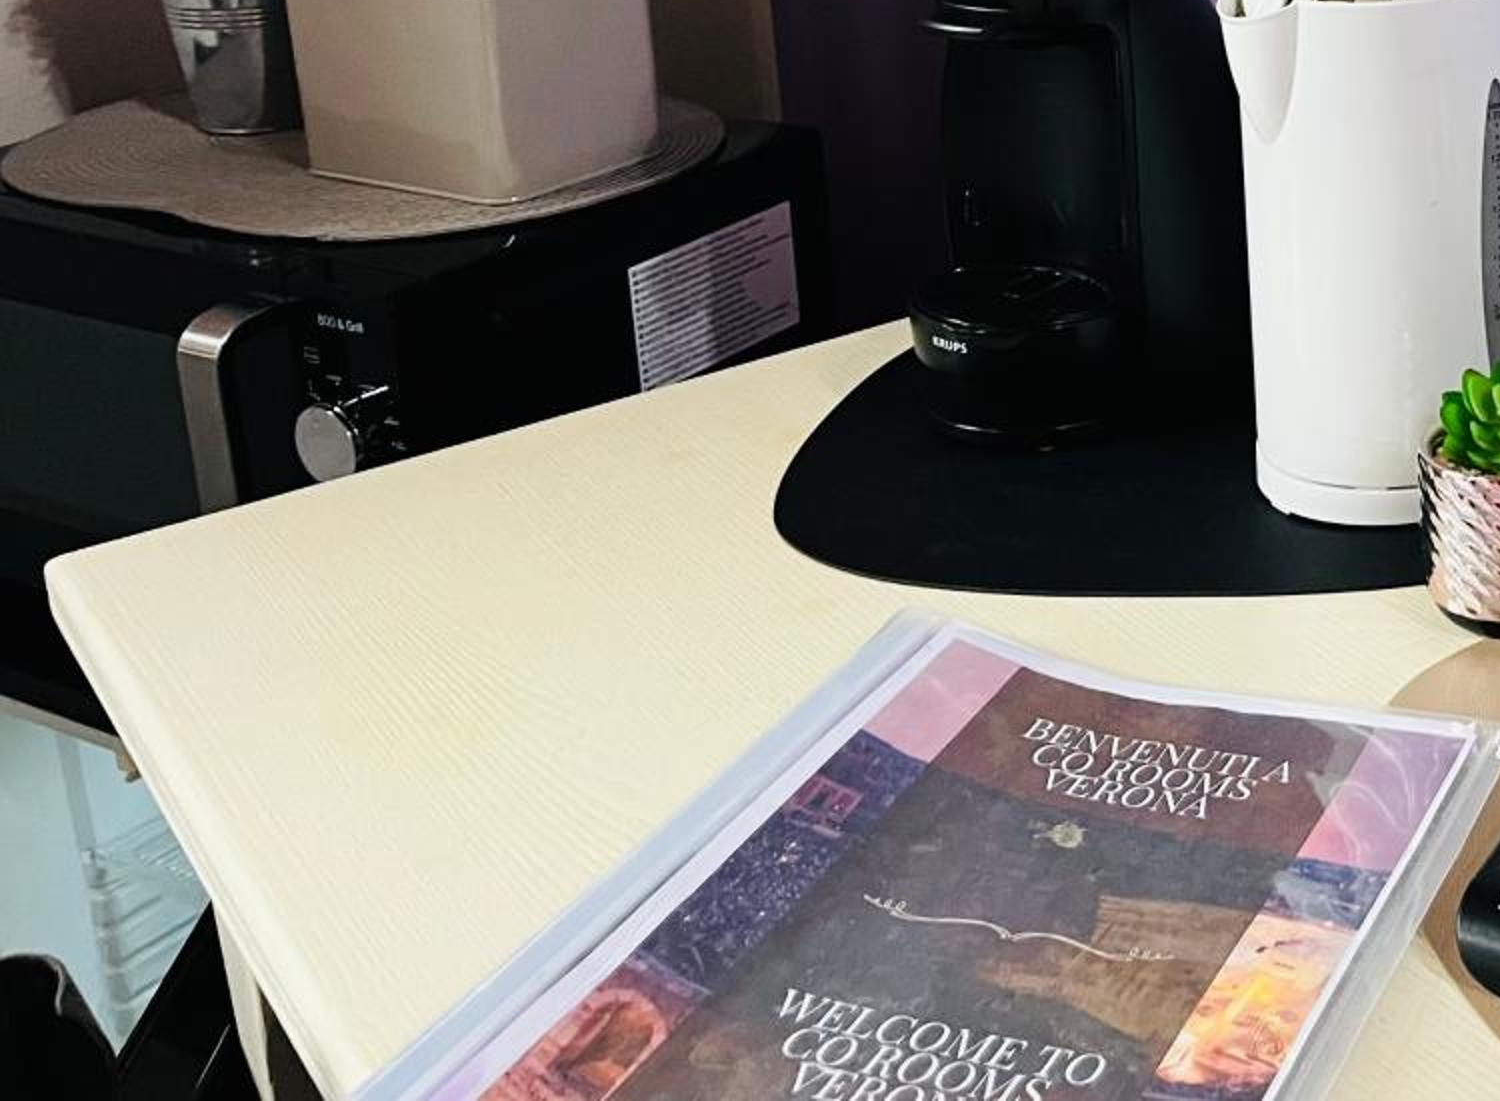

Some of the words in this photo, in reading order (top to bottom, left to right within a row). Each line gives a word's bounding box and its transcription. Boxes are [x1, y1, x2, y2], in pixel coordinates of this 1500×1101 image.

[1023, 718, 1261, 778] BENVENUTI
[1263, 760, 1291, 784] A
[1033, 744, 1094, 775] CO
[1100, 759, 1257, 800] ROOMS
[1046, 768, 1207, 819] VERONA
[778, 988, 1027, 1070] WELCOME
[1034, 1045, 1106, 1085] TO
[782, 1028, 858, 1065] CO
[861, 1045, 1051, 1101] ROOMS
[791, 1061, 968, 1101] VERO
